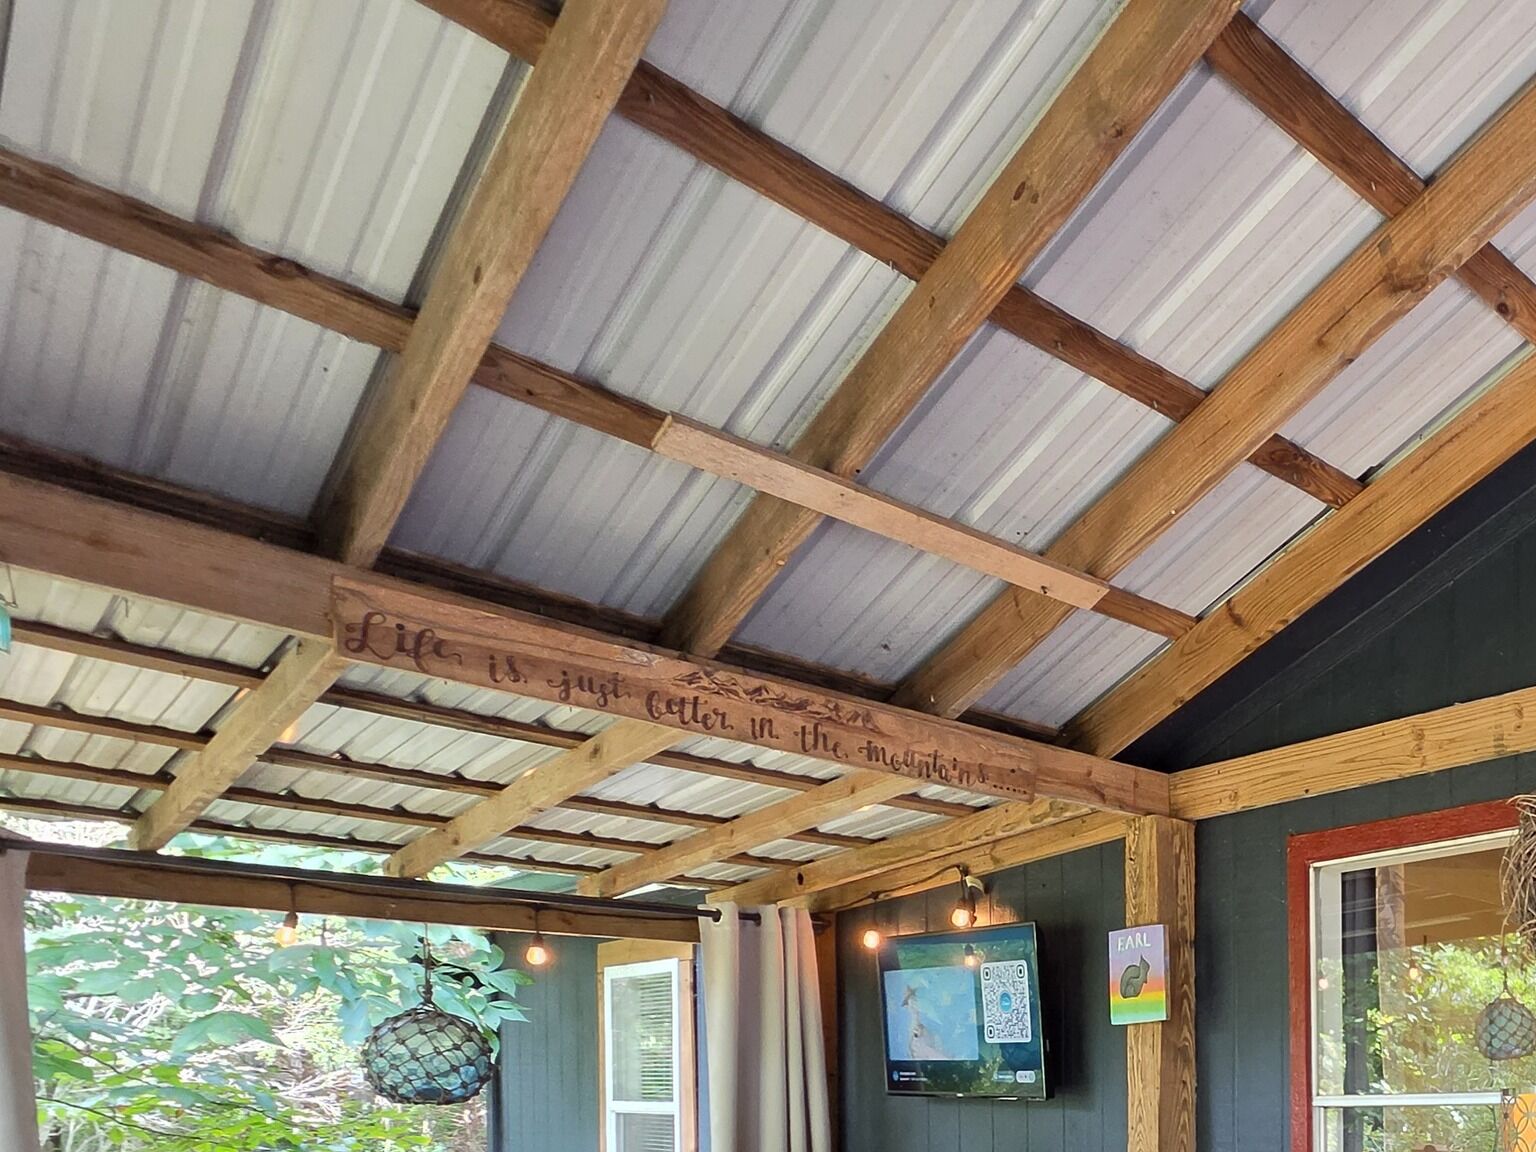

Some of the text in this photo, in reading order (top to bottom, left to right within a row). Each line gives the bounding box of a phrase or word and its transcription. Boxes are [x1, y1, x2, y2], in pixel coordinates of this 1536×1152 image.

[547, 669, 632, 708] just
[793, 721, 849, 760] the
[1117, 931, 1152, 951] EARL
